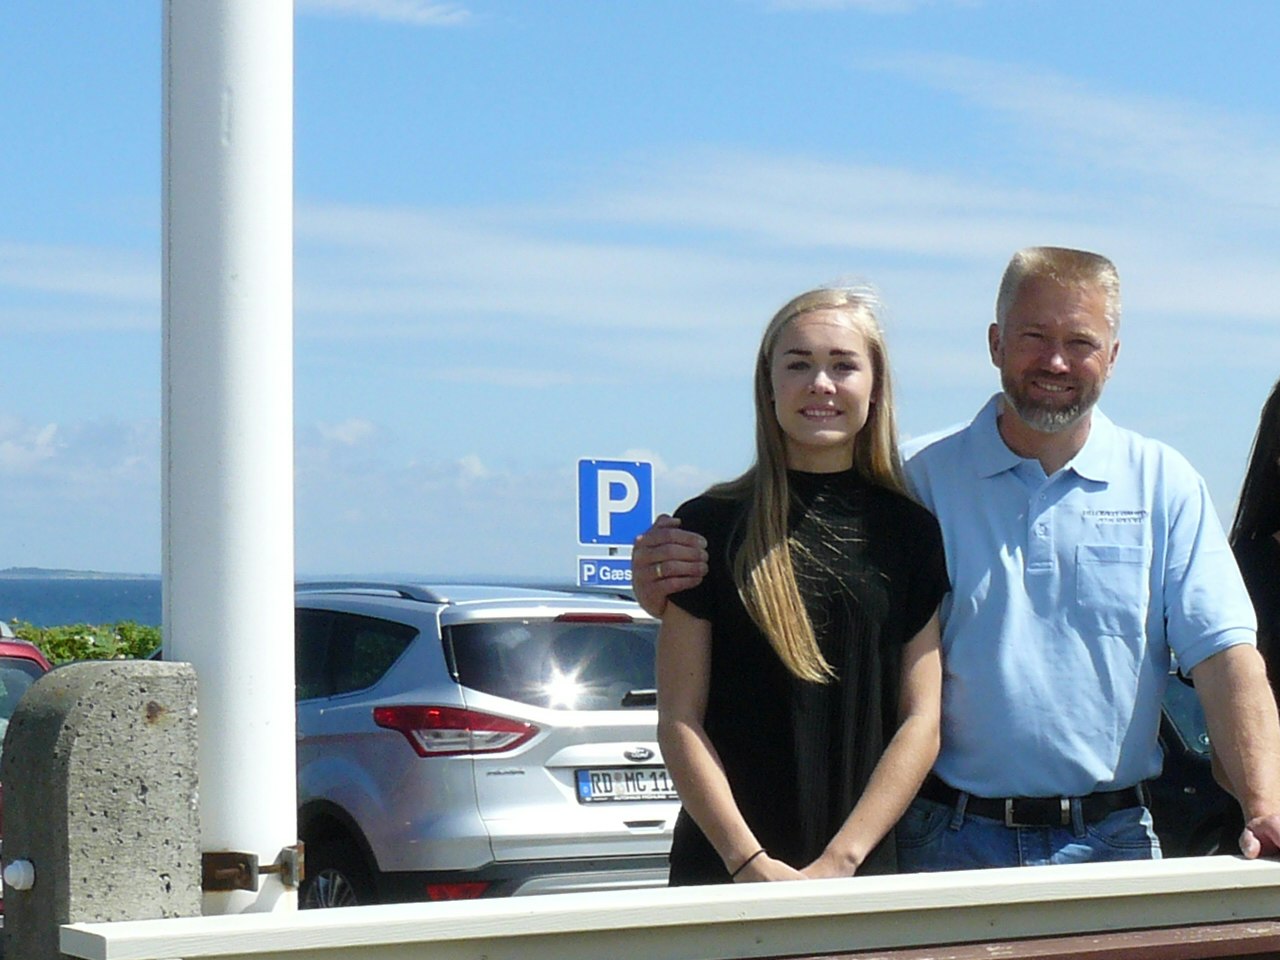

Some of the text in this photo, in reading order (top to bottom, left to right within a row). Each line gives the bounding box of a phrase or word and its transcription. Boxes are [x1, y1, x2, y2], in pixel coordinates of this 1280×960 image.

[597, 469, 640, 536] P
[583, 563, 632, 581] P Gæs
[591, 772, 613, 793] RD
[650, 771, 676, 792] 11
